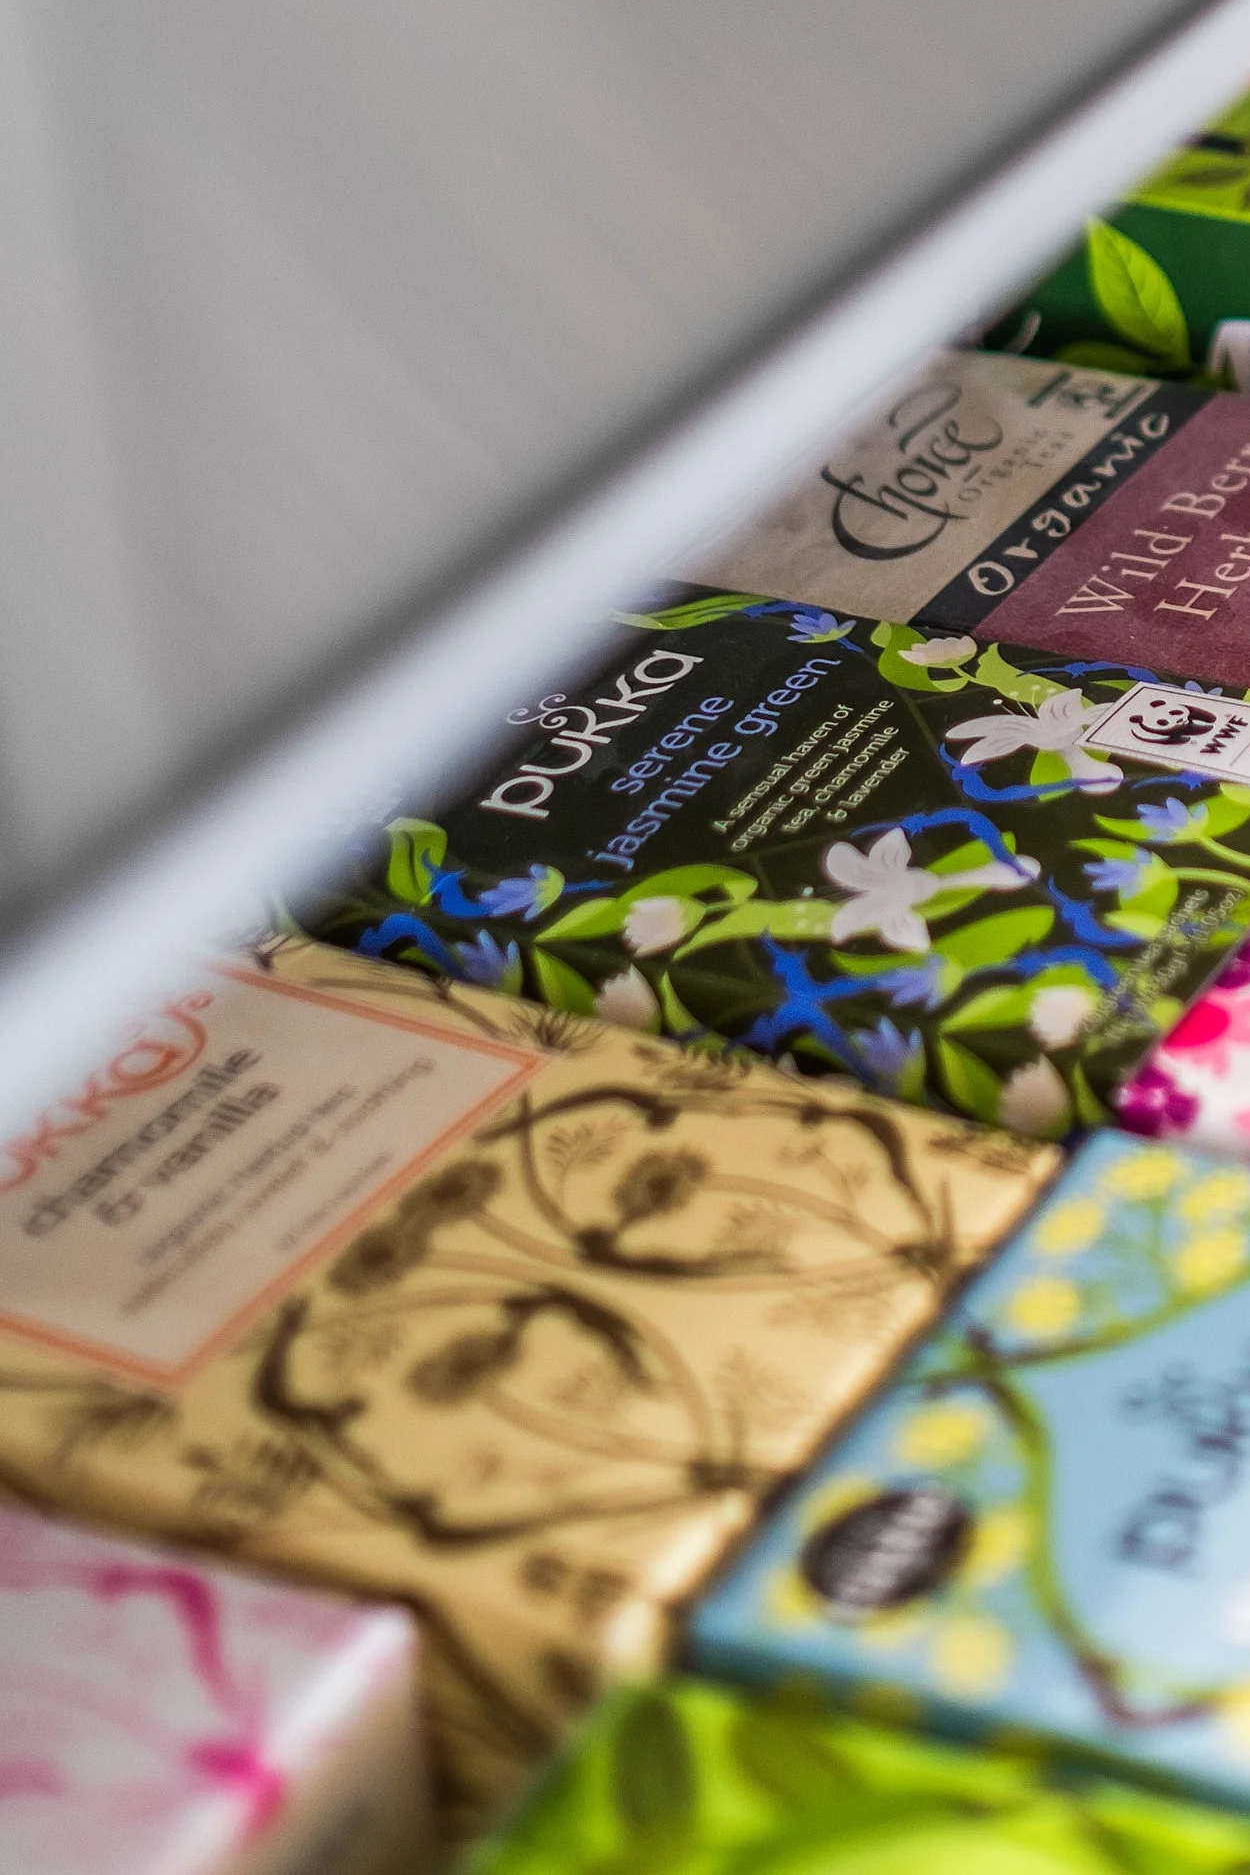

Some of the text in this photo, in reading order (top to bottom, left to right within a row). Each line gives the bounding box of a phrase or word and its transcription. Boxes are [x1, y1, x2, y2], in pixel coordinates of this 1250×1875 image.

[820, 382, 1005, 561] Choice
[967, 412, 1171, 596] Organic
[1054, 525, 1194, 620] Wild
[479, 648, 705, 820] pukka
[586, 657, 841, 870] jasmine green
[609, 694, 736, 795] serene
[713, 703, 855, 834] A sensual haven of
[731, 699, 894, 853] organic green jasmine
[781, 726, 900, 833] tea, chamomile
[838, 747, 910, 808] lavender
[1199, 714, 1249, 755] WWF
[20, 1047, 262, 1239] chamomile
[141, 1082, 283, 1189] vanilla
